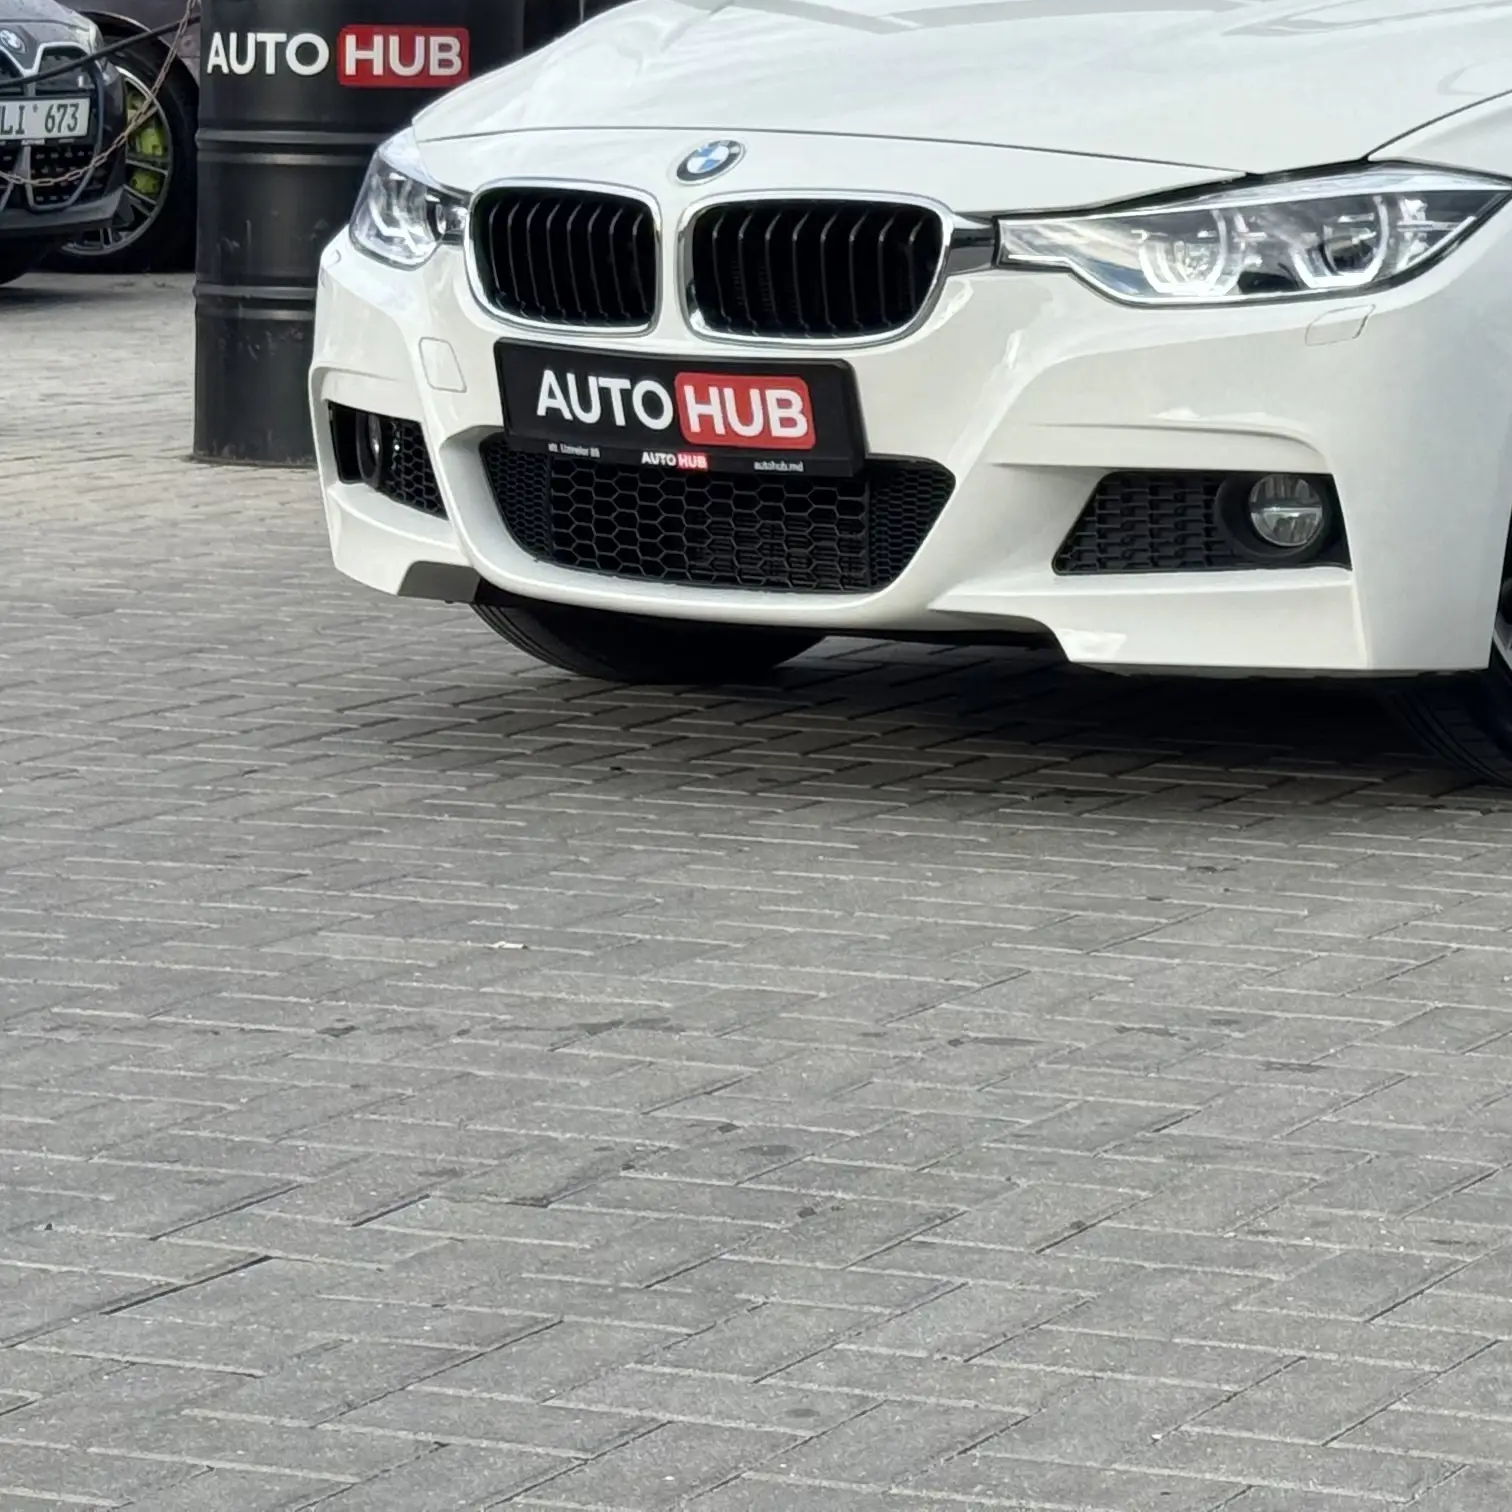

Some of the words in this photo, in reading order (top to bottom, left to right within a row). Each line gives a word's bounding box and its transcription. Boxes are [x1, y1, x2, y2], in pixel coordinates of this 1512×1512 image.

[206, 32, 330, 76] AUTO
[345, 34, 463, 77] HUB
[44, 102, 80, 134] 673
[536, 369, 674, 430] AUTO
[683, 384, 809, 439] HUB
[641, 451, 676, 467] AUTO
[677, 453, 708, 470] HUB
